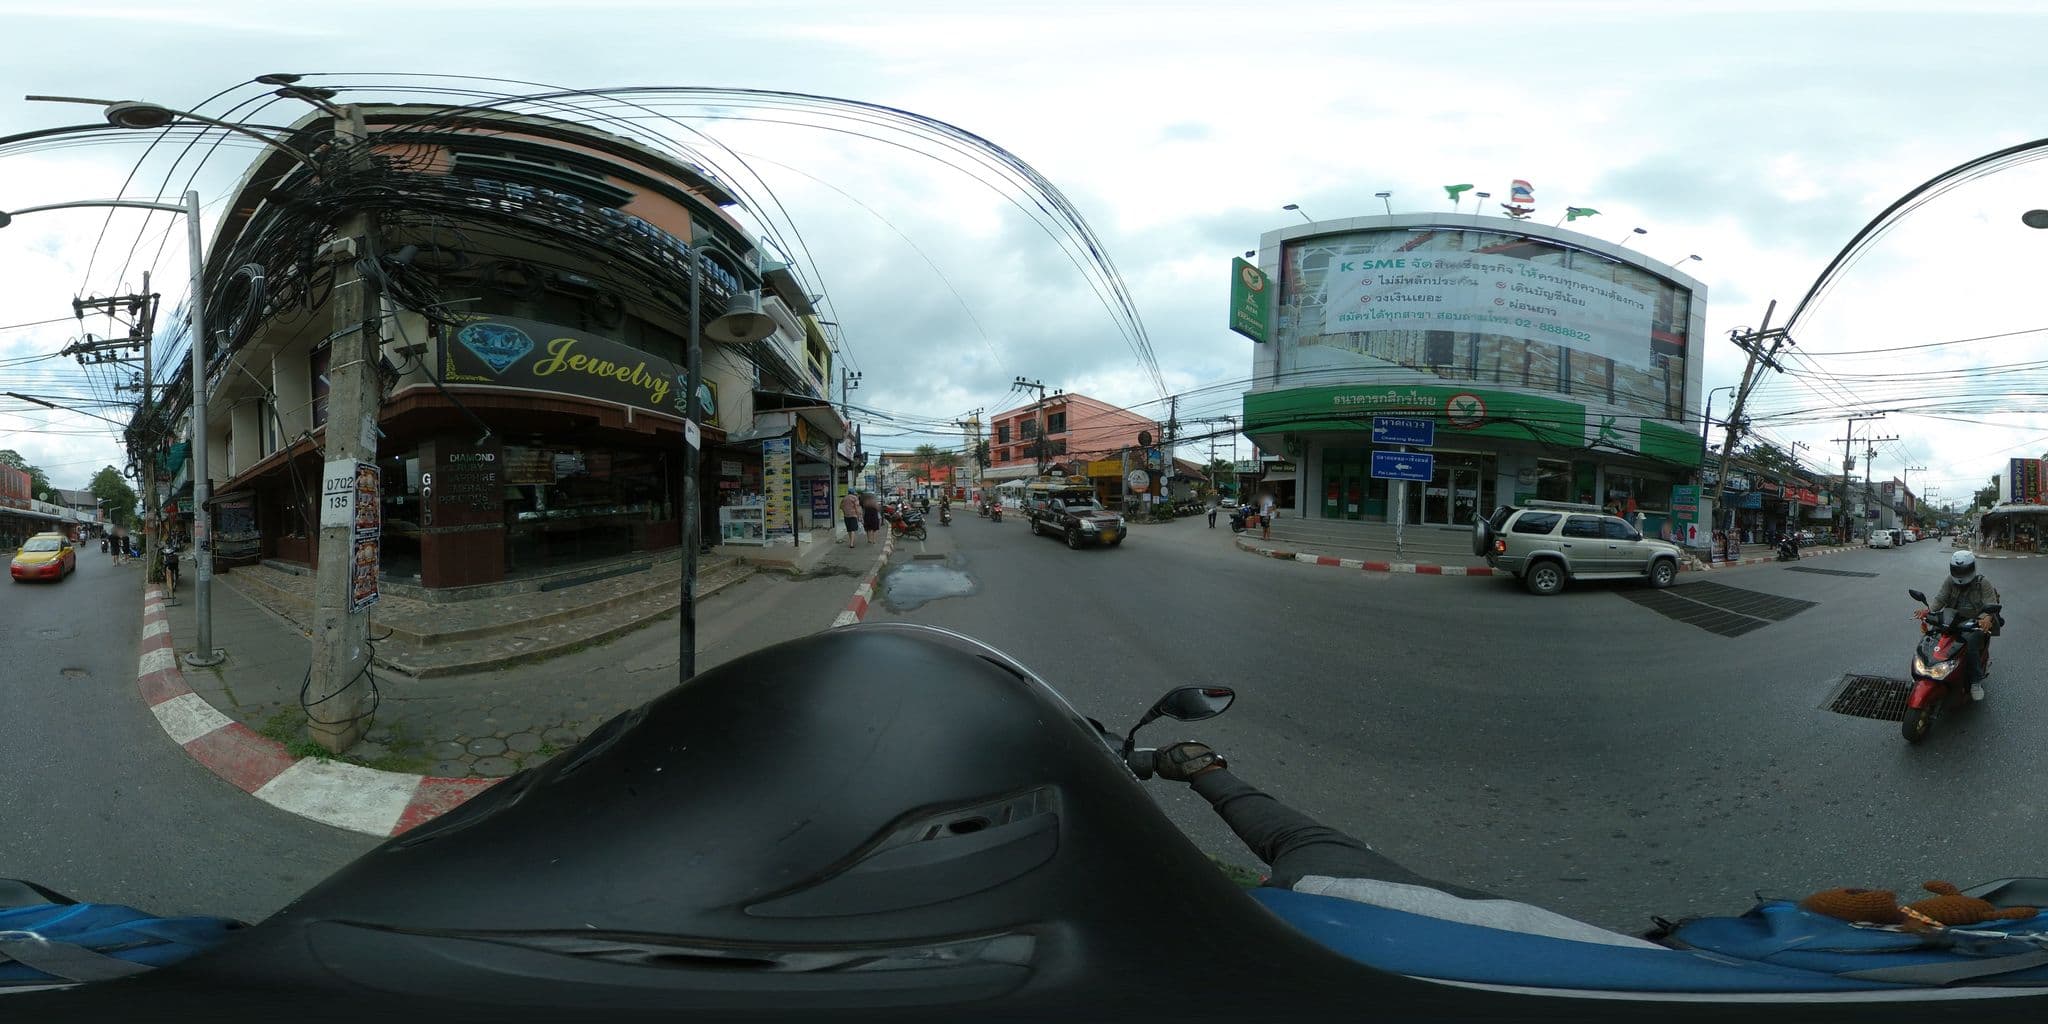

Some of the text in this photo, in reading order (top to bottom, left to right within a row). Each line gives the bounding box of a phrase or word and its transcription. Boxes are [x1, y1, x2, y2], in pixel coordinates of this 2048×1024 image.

[1341, 261, 1354, 272] K
[1362, 258, 1406, 270] SME
[1375, 292, 1443, 303] วงเงินเยอะ
[532, 338, 671, 404] Jewelry
[1333, 390, 1437, 406] ธนาคารกสิกรไทย
[449, 453, 496, 462] DIAMOND
[327, 477, 354, 491] 0702
[329, 496, 348, 509] 135
[422, 472, 433, 526] GOLD
